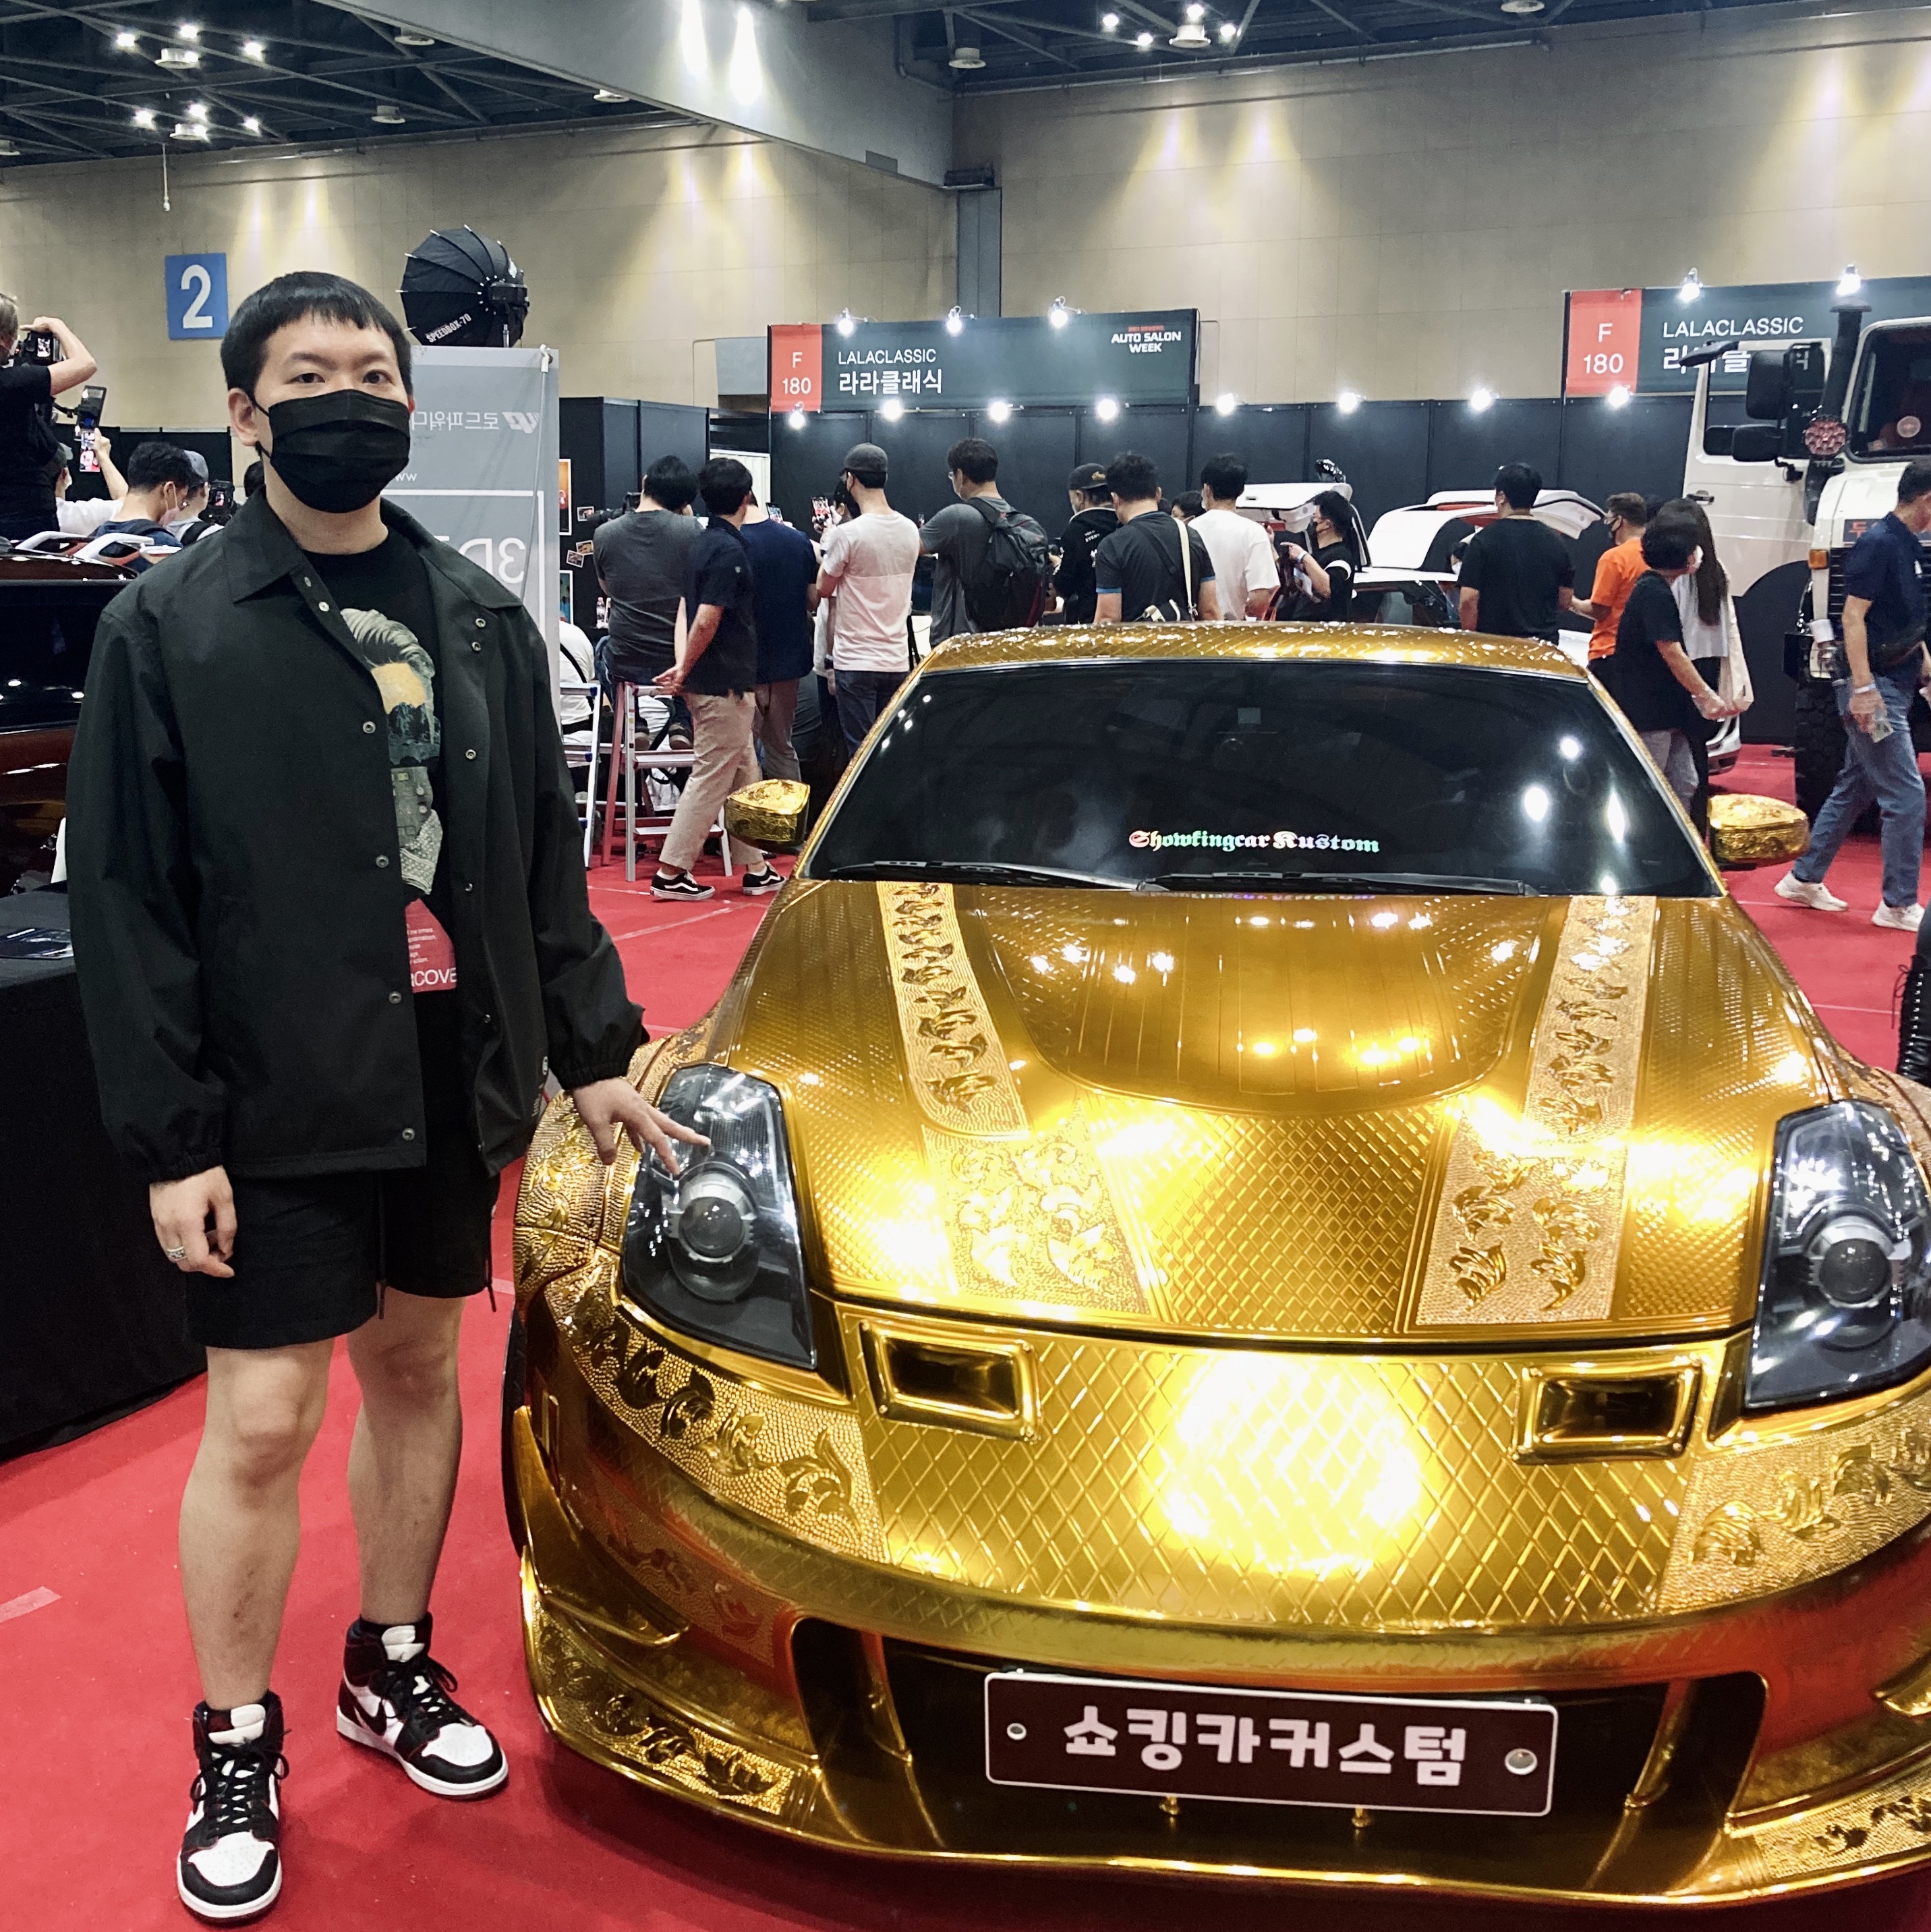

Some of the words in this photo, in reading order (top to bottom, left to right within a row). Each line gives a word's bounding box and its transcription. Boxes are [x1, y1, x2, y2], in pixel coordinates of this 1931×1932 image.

[181, 264, 213, 329] 2
[426, 313, 471, 343] SPEEDBOX-70
[1111, 333, 1141, 344] AUTO
[1144, 331, 1182, 343] SALON
[1598, 323, 1613, 342] F
[1663, 316, 1804, 338] LALACLASSIC
[838, 348, 937, 365] LALACLASSIC
[1128, 343, 1162, 353] WEEK
[792, 351, 803, 368] F
[1583, 353, 1624, 375] 180
[782, 376, 812, 395] 180
[839, 368, 943, 395] 라라클래식
[1273, 830, 1380, 853] Kustom
[1063, 1705, 1466, 1786] 쇼킹카커스텀
